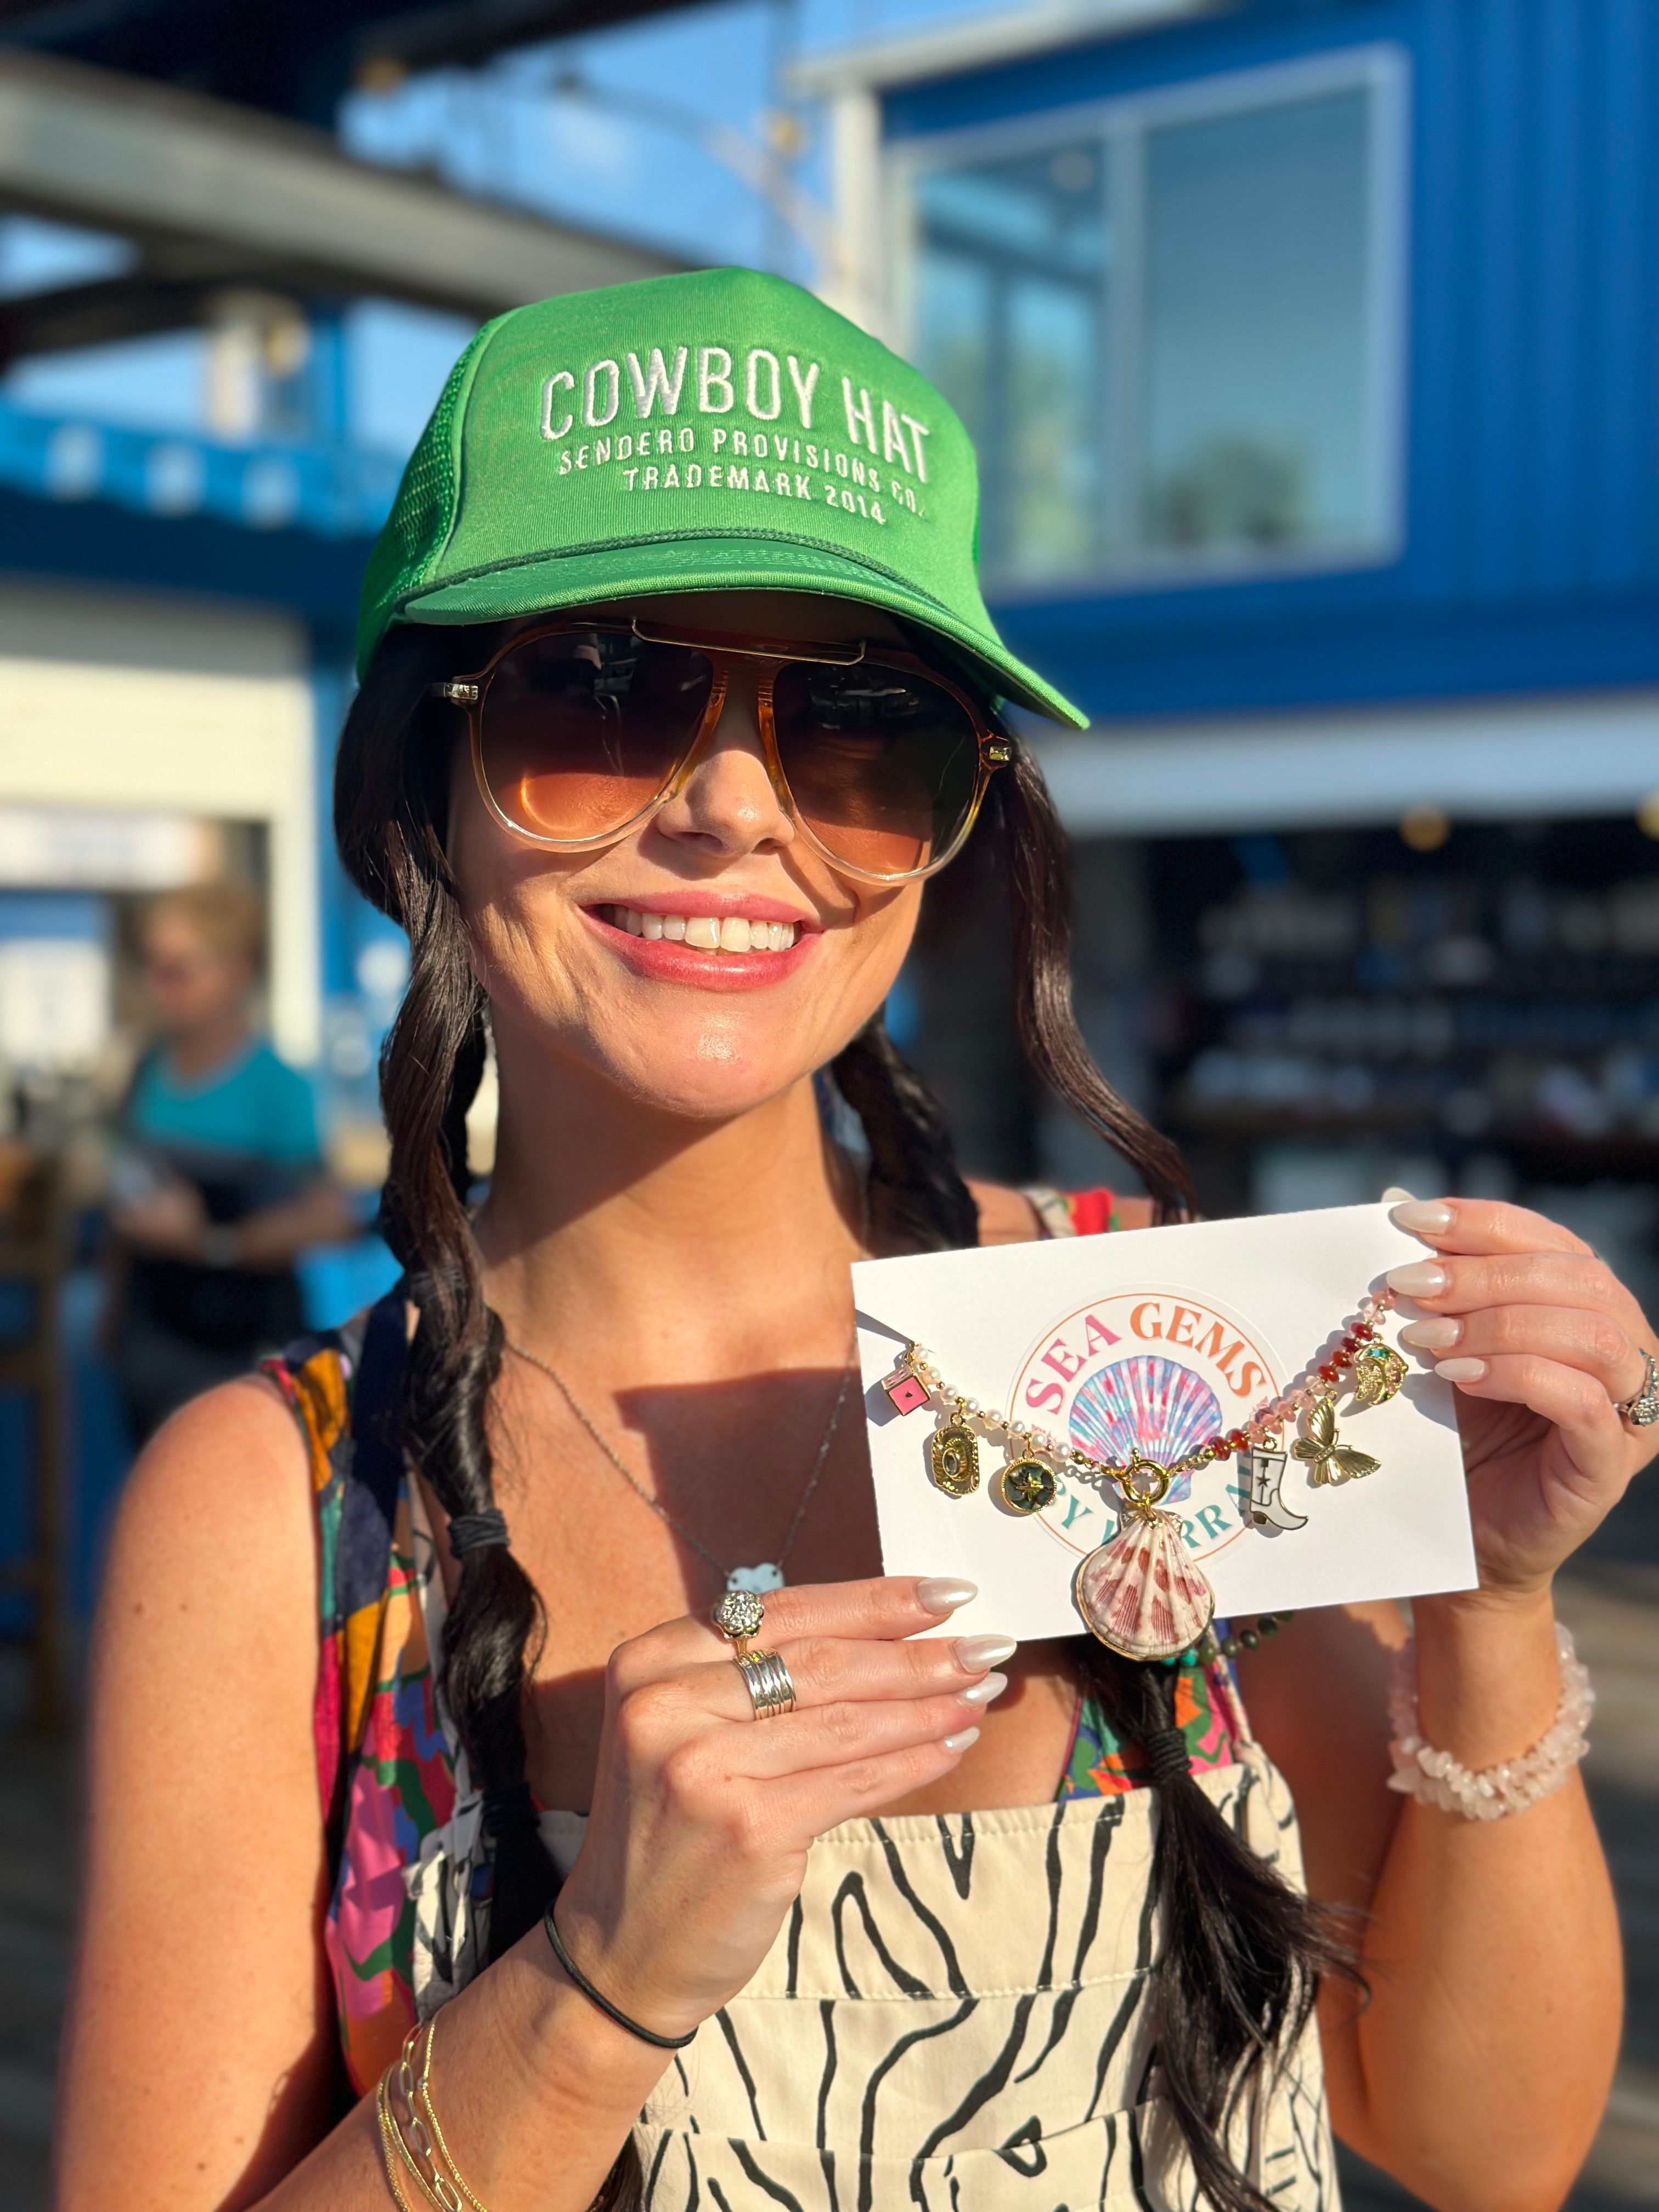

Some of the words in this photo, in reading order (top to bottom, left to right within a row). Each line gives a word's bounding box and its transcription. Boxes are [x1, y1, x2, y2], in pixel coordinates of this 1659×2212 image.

[540, 347, 819, 441] COWBOY
[842, 376, 929, 482] HAT
[559, 427, 695, 475] SENDERO
[712, 428, 880, 492] PROVISIONS
[890, 481, 926, 518] CO.
[622, 464, 812, 501] TRADEMARK
[824, 484, 886, 524] 2014
[1026, 1314, 1122, 1415] SEA
[1130, 1302, 1266, 1397] GEMS
